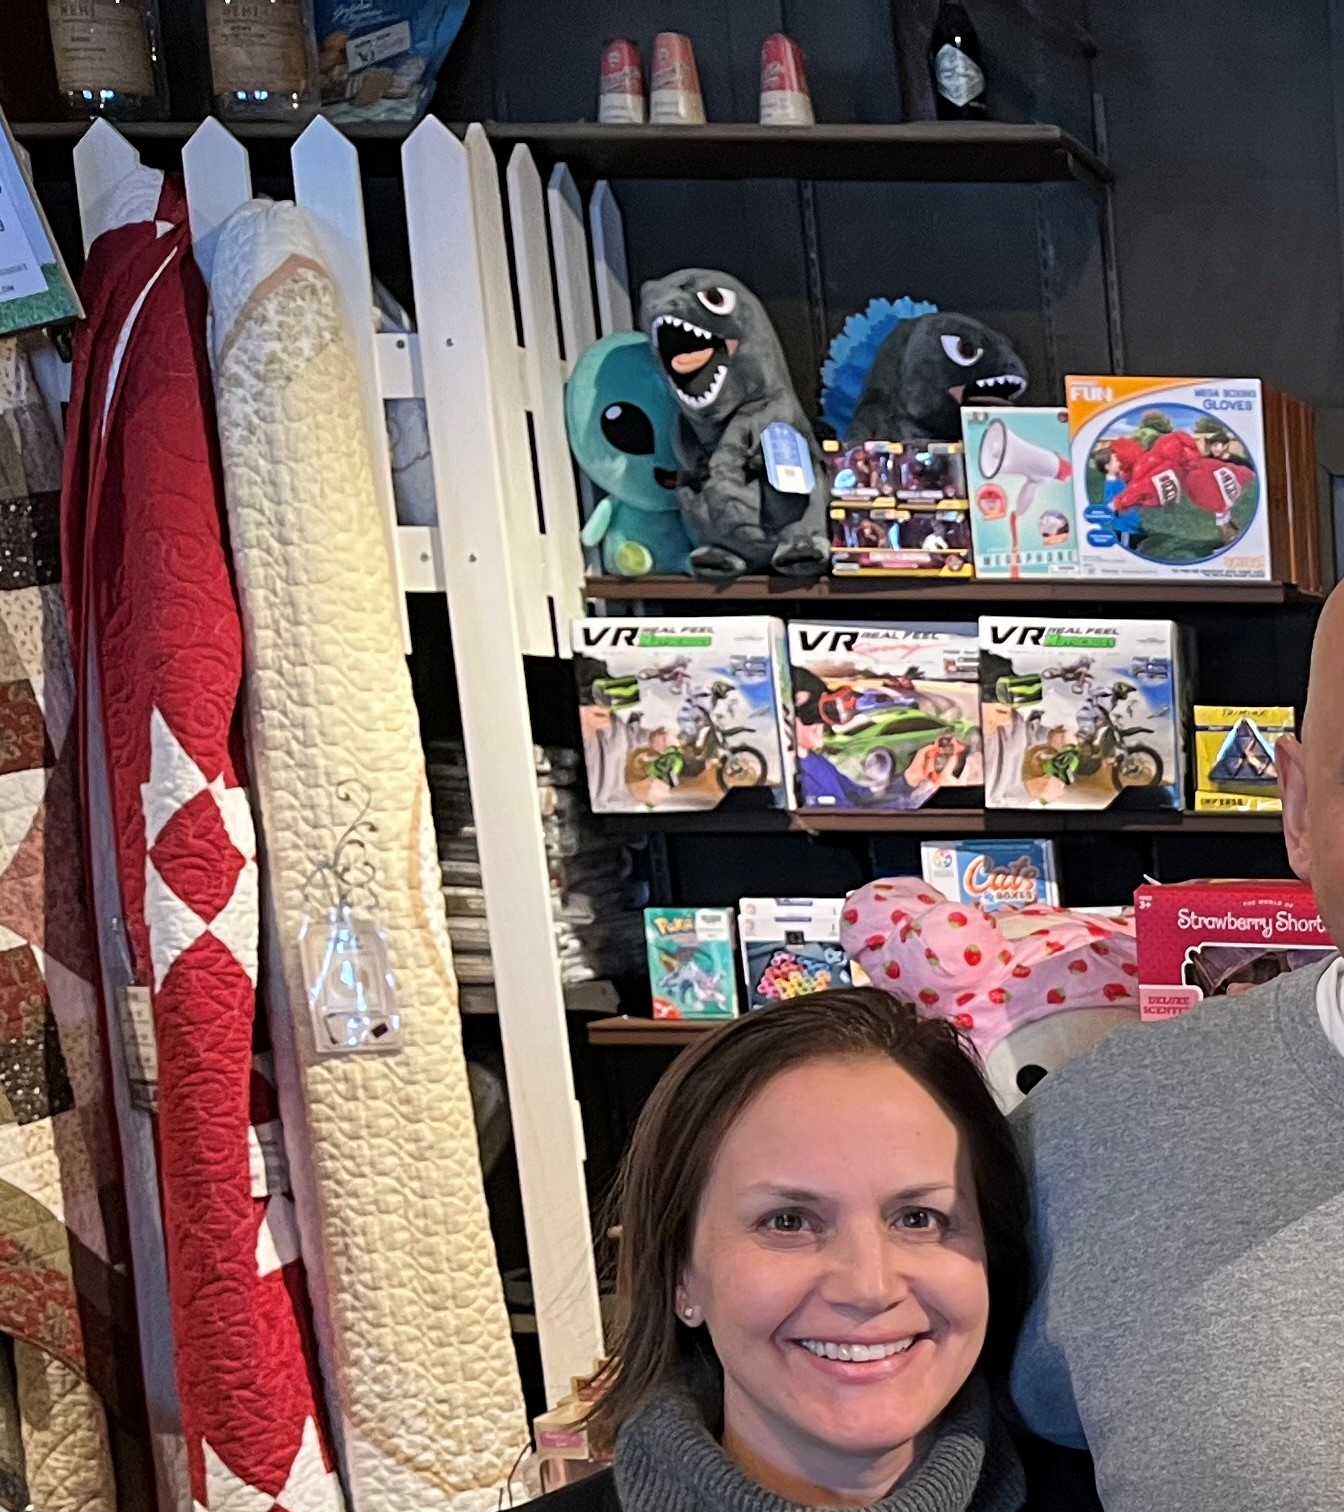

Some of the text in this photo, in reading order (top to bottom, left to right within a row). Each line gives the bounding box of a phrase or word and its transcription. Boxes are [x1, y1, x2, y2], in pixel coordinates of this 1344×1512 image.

[1071, 387, 1114, 402] FUN
[1203, 399, 1252, 411] GLOVES
[582, 627, 638, 646] VR
[799, 631, 859, 651] VR
[991, 626, 1046, 646] VR
[1048, 627, 1082, 635] REAL
[1086, 627, 1119, 635] FEEL
[1177, 908, 1273, 938] Strawberry
